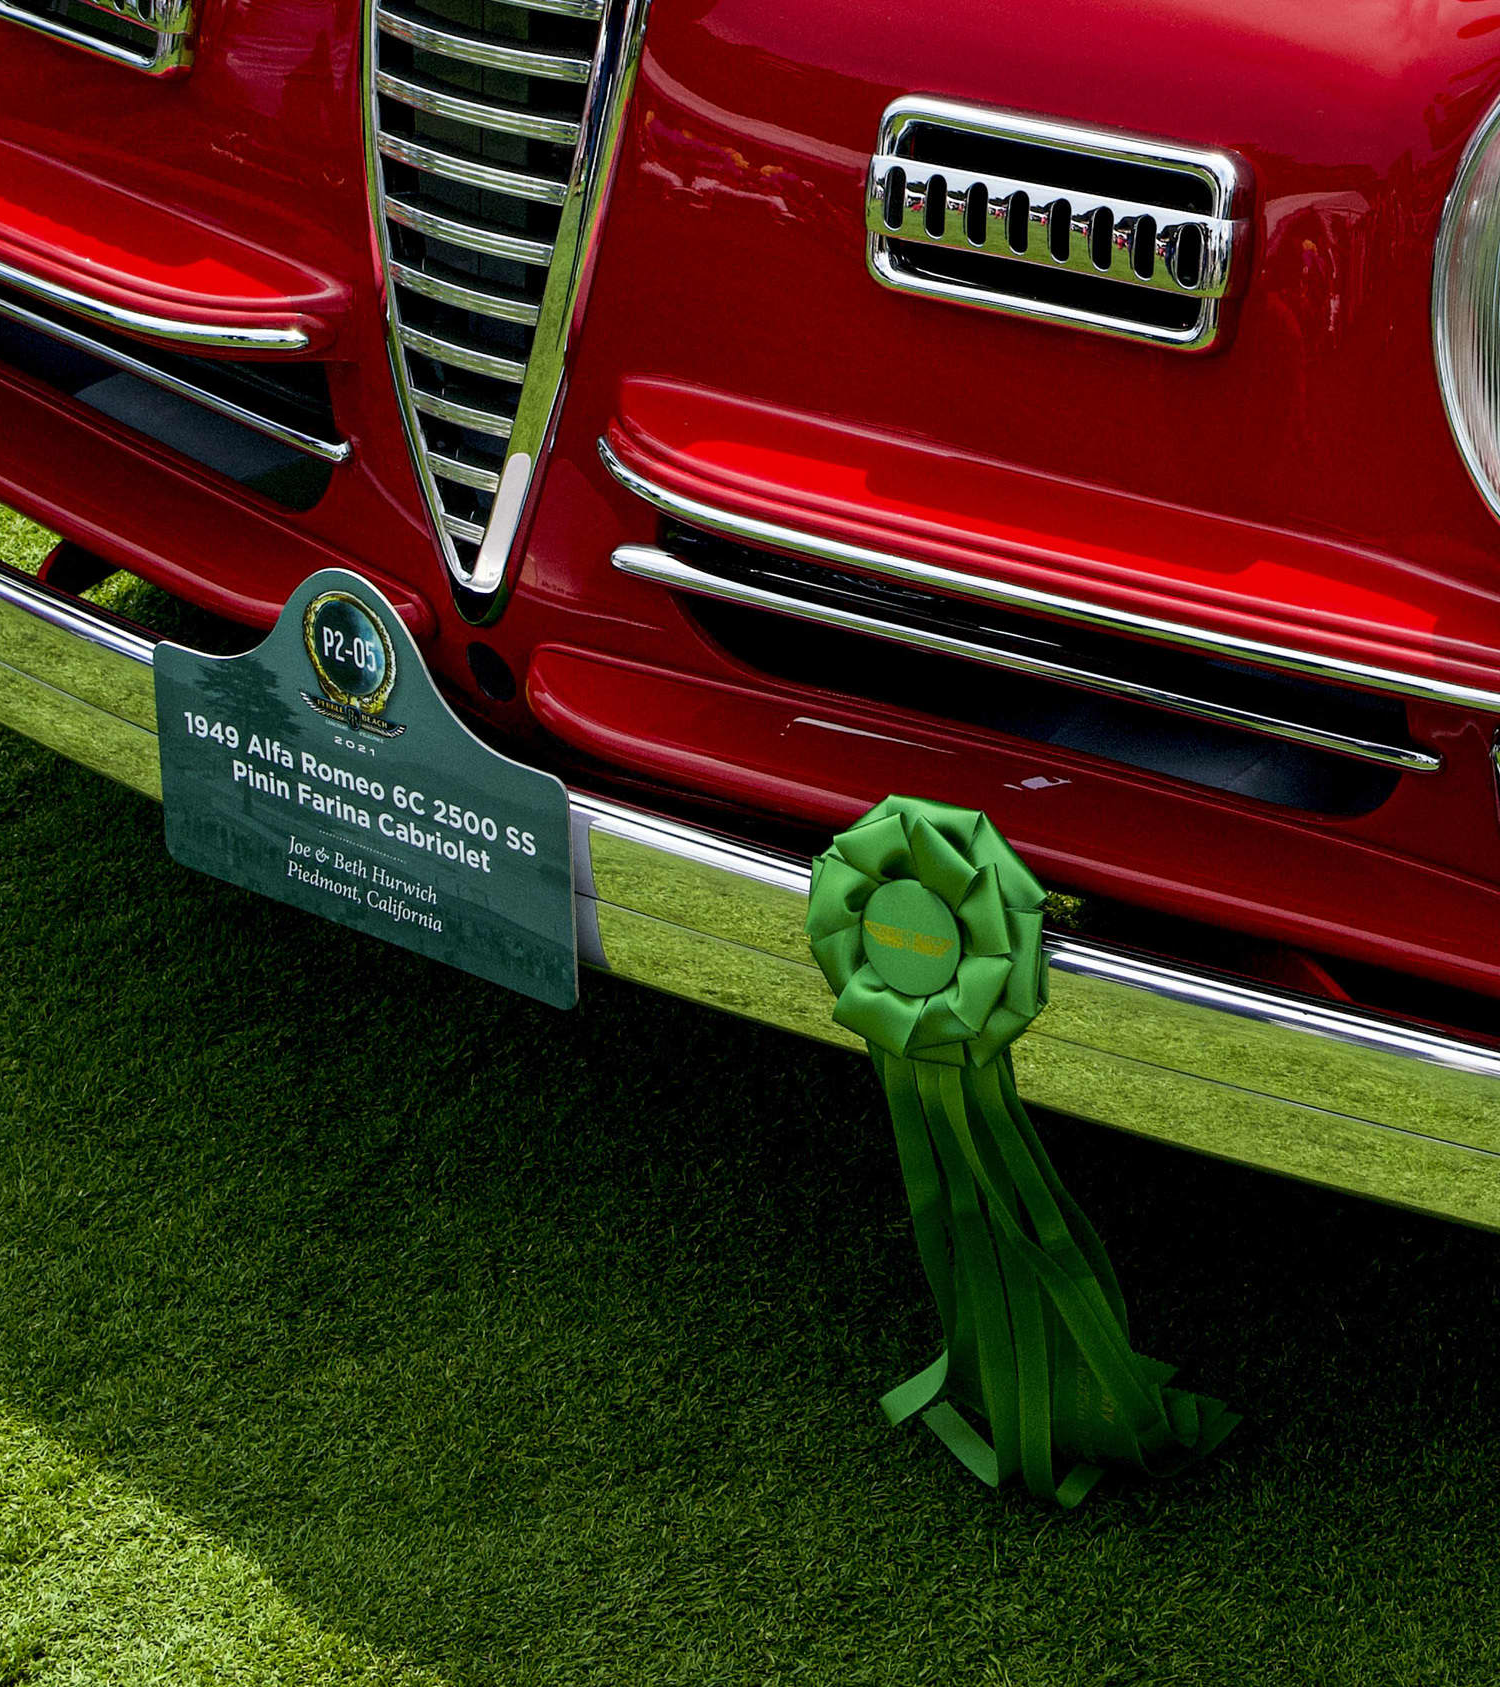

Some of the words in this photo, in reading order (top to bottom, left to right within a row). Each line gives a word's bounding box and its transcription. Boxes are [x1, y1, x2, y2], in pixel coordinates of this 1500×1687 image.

[322, 626, 377, 673] P2-05
[333, 735, 376, 757] 2021
[184, 711, 239, 749] 1949
[247, 733, 294, 770] Alfa
[301, 751, 385, 802] Romeo
[392, 785, 426, 816] 6C
[432, 799, 498, 842] 2500
[505, 825, 537, 857] SS
[232, 759, 291, 800] Pinin
[297, 782, 371, 829] Farina
[378, 813, 491, 874] Cabriolet
[287, 860, 362, 904] Piedmont,
[366, 890, 443, 933] California
[288, 835, 311, 858] Joe
[315, 847, 330, 864] &
[334, 851, 368, 879] Beth
[372, 865, 438, 905] Hurwich
